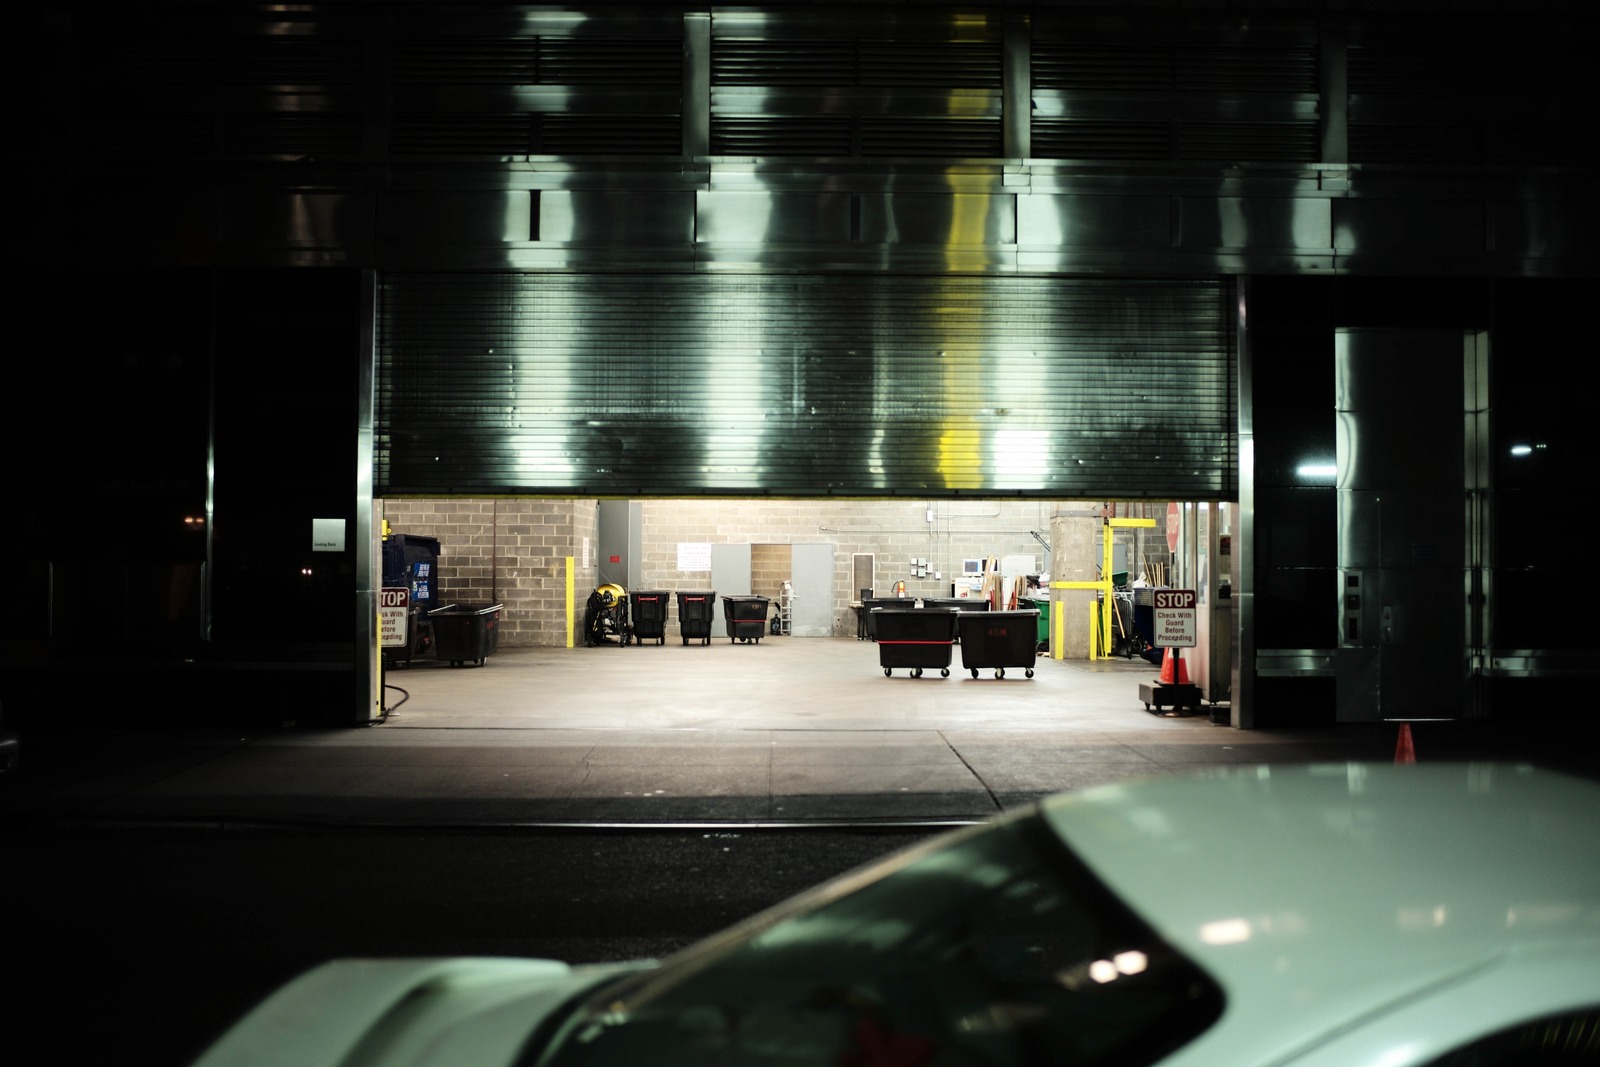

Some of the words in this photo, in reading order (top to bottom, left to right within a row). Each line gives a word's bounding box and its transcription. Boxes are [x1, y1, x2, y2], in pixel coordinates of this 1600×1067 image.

[1167, 513, 1178, 534] STOP
[381, 591, 406, 606] TOP
[1156, 593, 1193, 607] STOP
